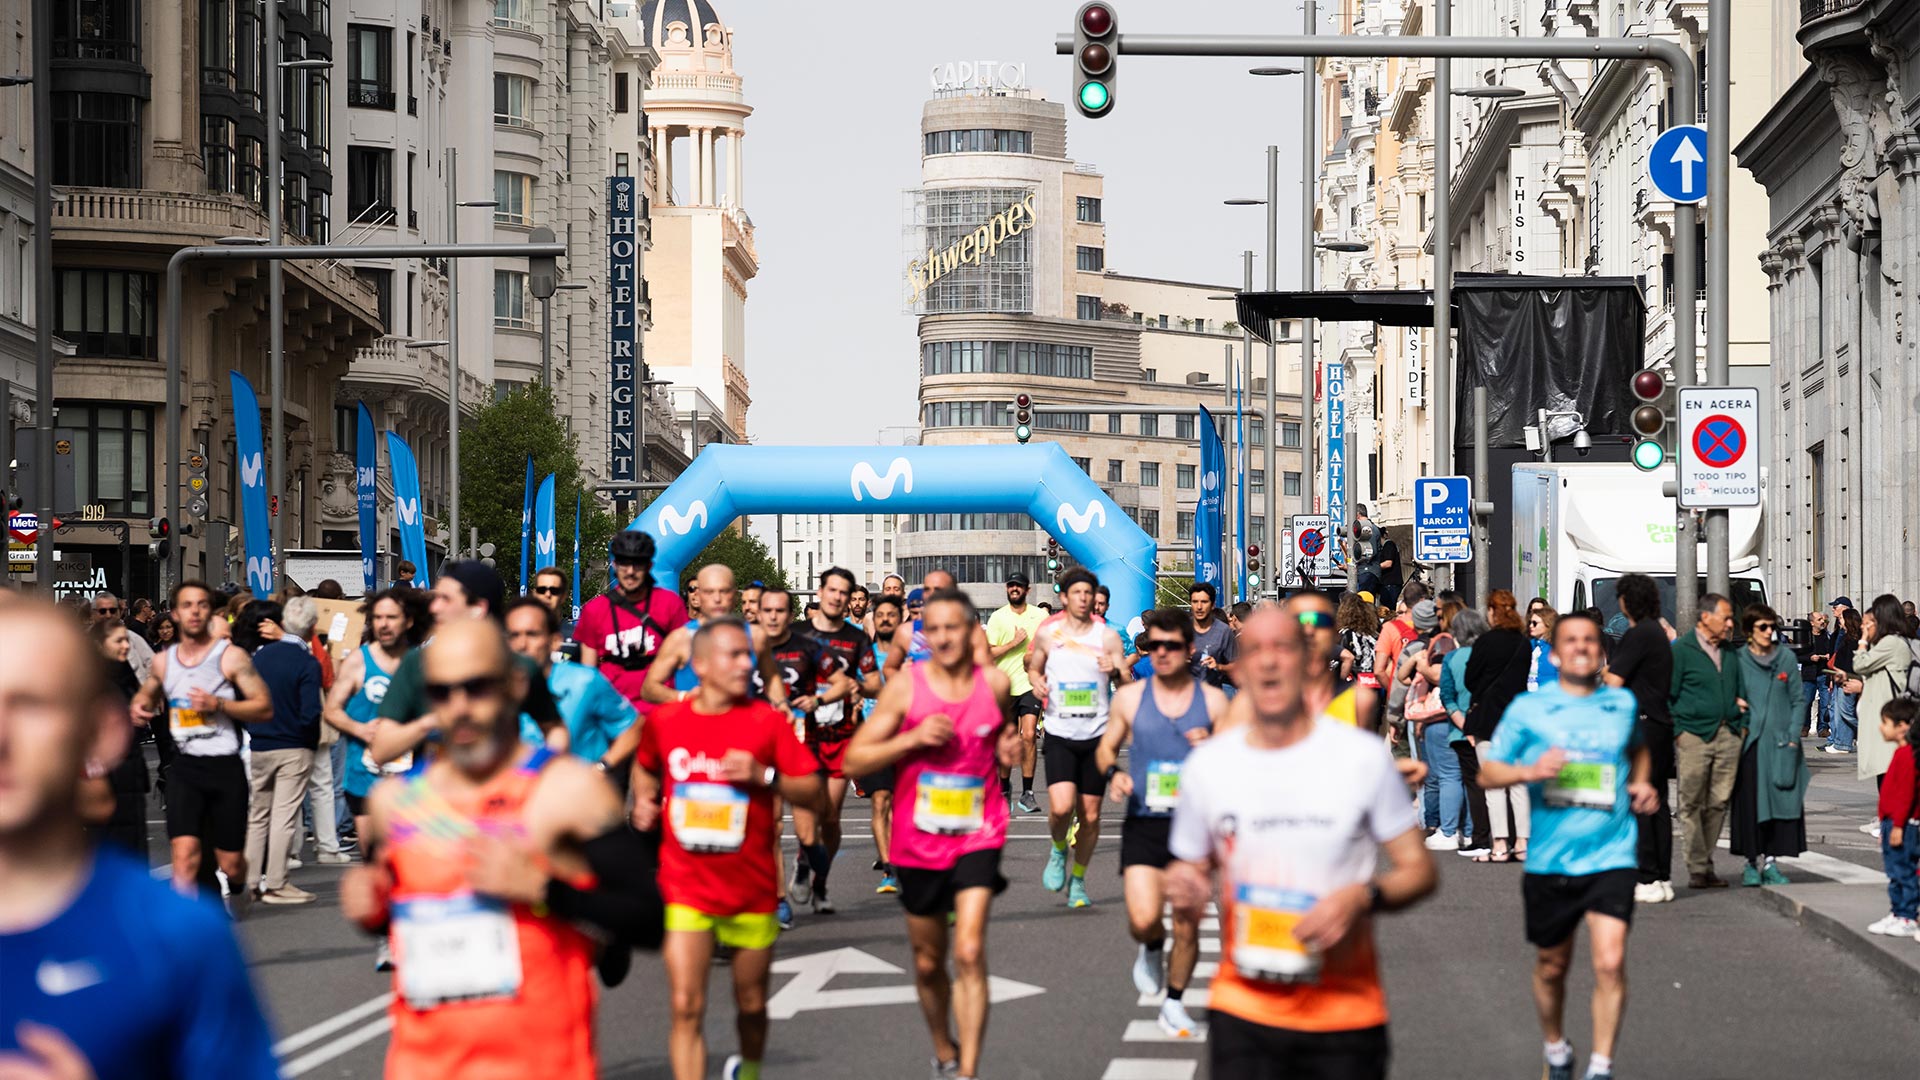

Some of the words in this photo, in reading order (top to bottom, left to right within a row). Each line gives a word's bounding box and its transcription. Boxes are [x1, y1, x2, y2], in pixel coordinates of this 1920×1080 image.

[1515, 176, 1525, 228] THIS
[906, 193, 1037, 304] Schweppes
[1515, 238, 1525, 262] IS
[612, 217, 634, 327] HOTEL
[1329, 366, 1342, 439] HOTEL
[1686, 400, 1702, 409] EN
[1710, 400, 1752, 409] ACERA
[1725, 472, 1747, 480] TIPO
[1423, 482, 1449, 514] P
[82, 504, 105, 521] 1919
[1446, 506, 1456, 514] 24
[1457, 506, 1463, 514] H
[1423, 517, 1454, 526] BARCO
[1457, 517, 1462, 525] 1
[56, 562, 86, 571] KIKO
